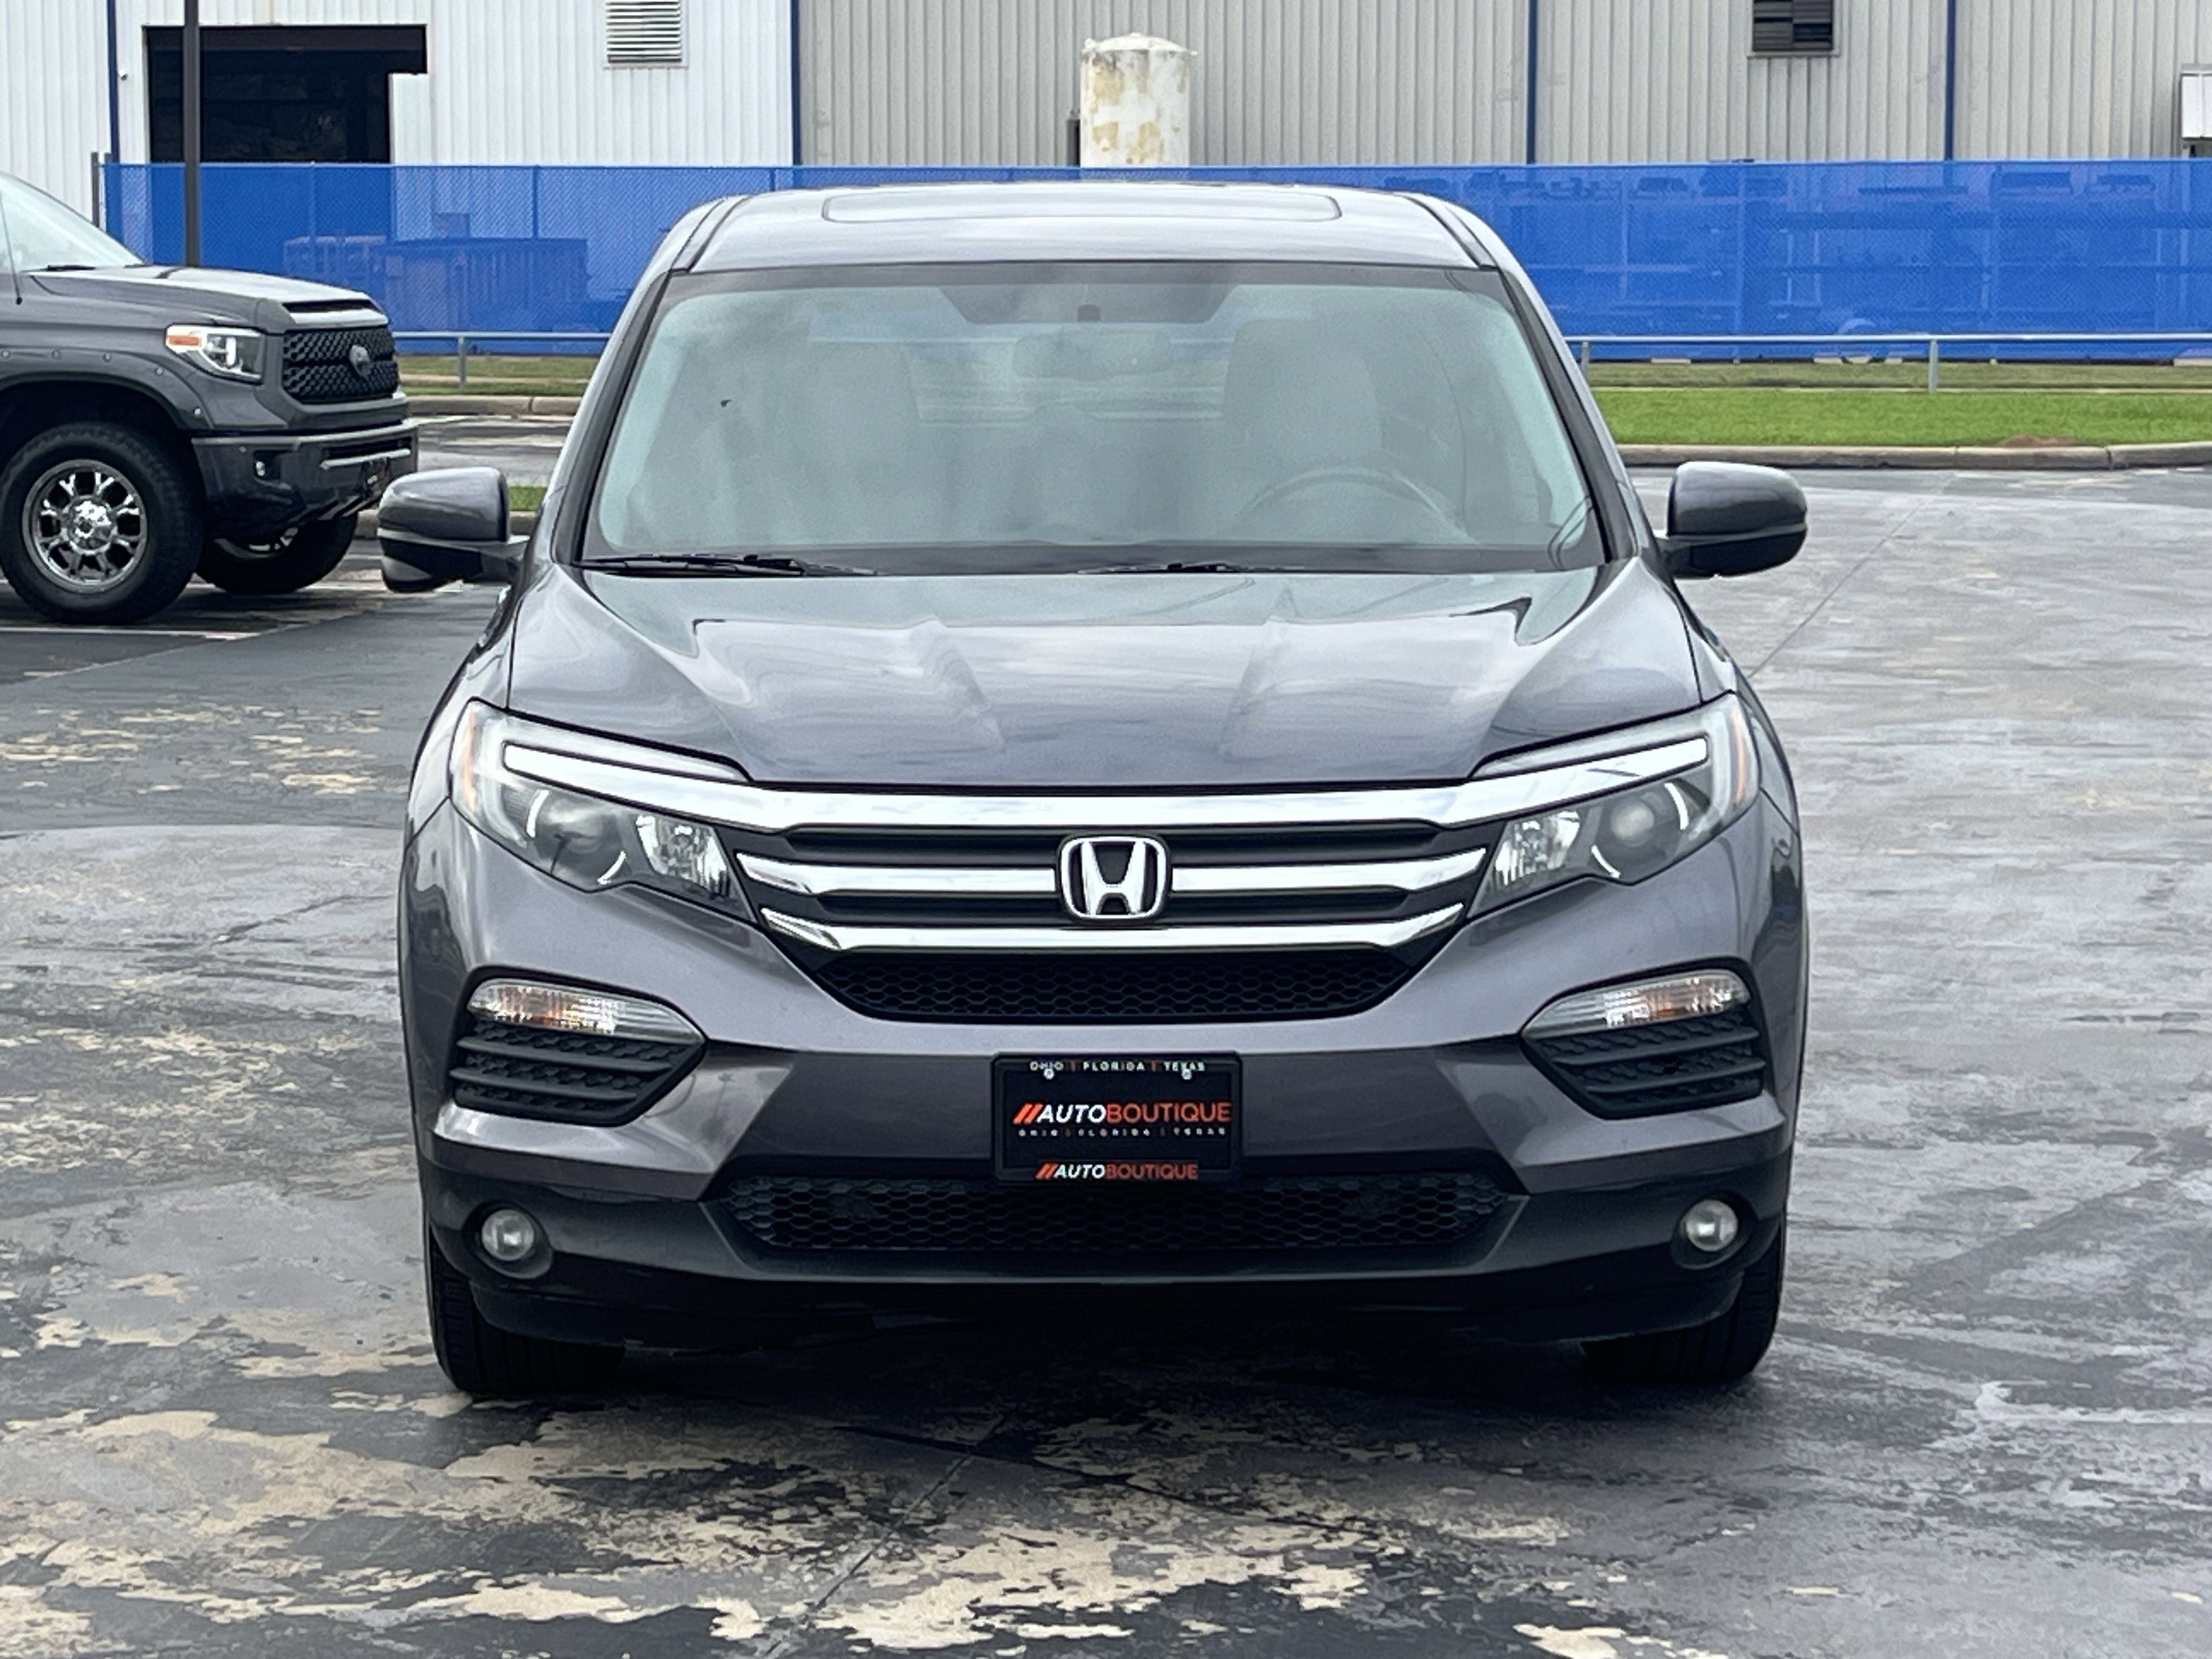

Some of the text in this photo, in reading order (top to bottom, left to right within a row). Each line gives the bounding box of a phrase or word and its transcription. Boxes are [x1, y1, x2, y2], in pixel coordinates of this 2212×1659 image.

[1083, 1061, 1146, 1071] FLORIDA
[1164, 1062, 1206, 1071] TEXAS
[1036, 1103, 1232, 1123] AUTOBOUTIQUE
[1054, 1164, 1198, 1179] AUTOBOUTIQUE
